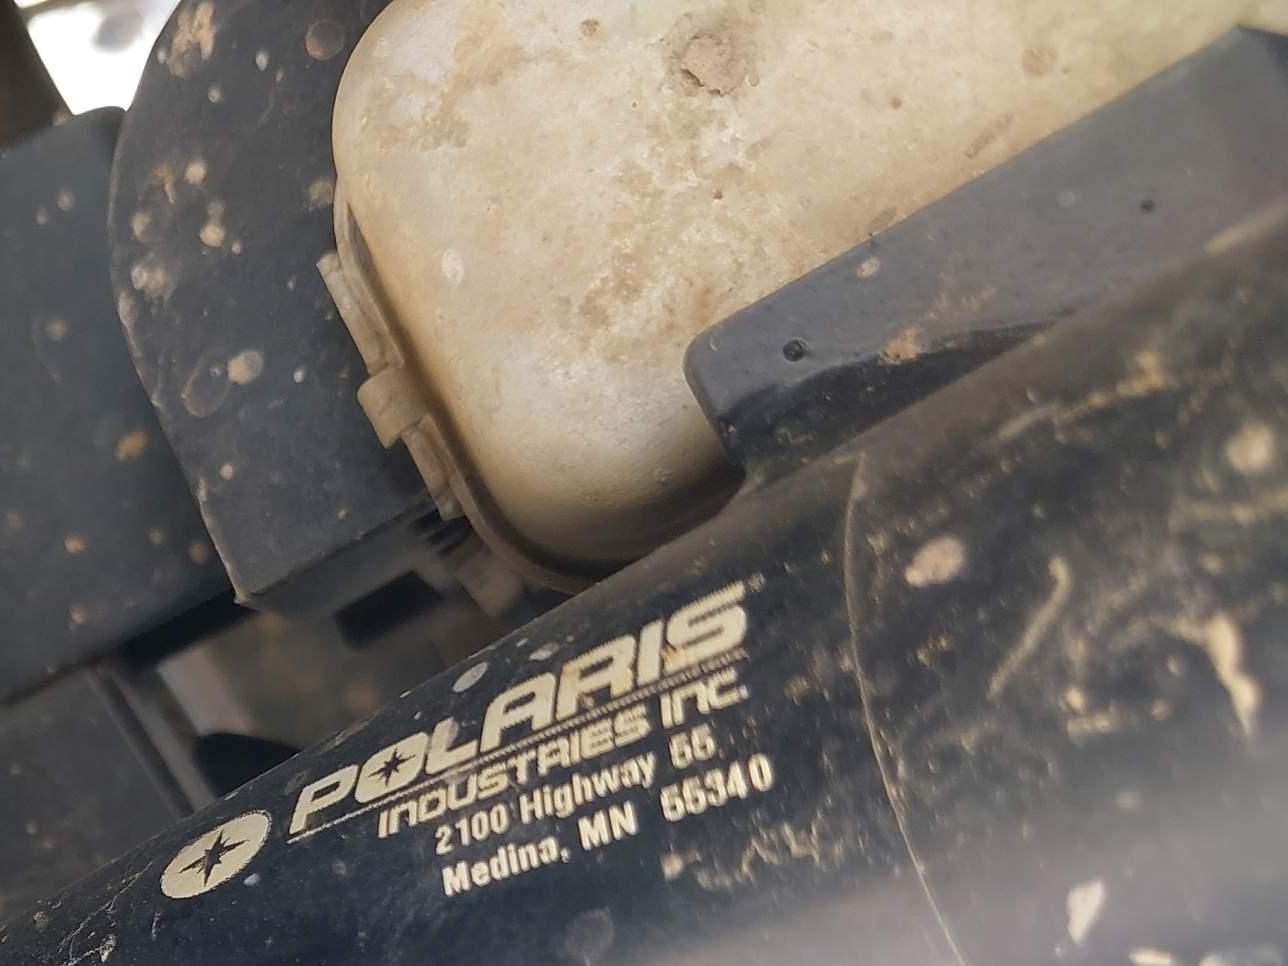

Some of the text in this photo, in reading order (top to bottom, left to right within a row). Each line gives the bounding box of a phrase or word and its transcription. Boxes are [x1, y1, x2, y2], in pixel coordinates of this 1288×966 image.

[288, 581, 748, 834] POLARIS
[435, 804, 509, 856] 2100
[520, 751, 656, 825] Highway
[441, 835, 571, 897] Medina,
[578, 801, 638, 851] MN
